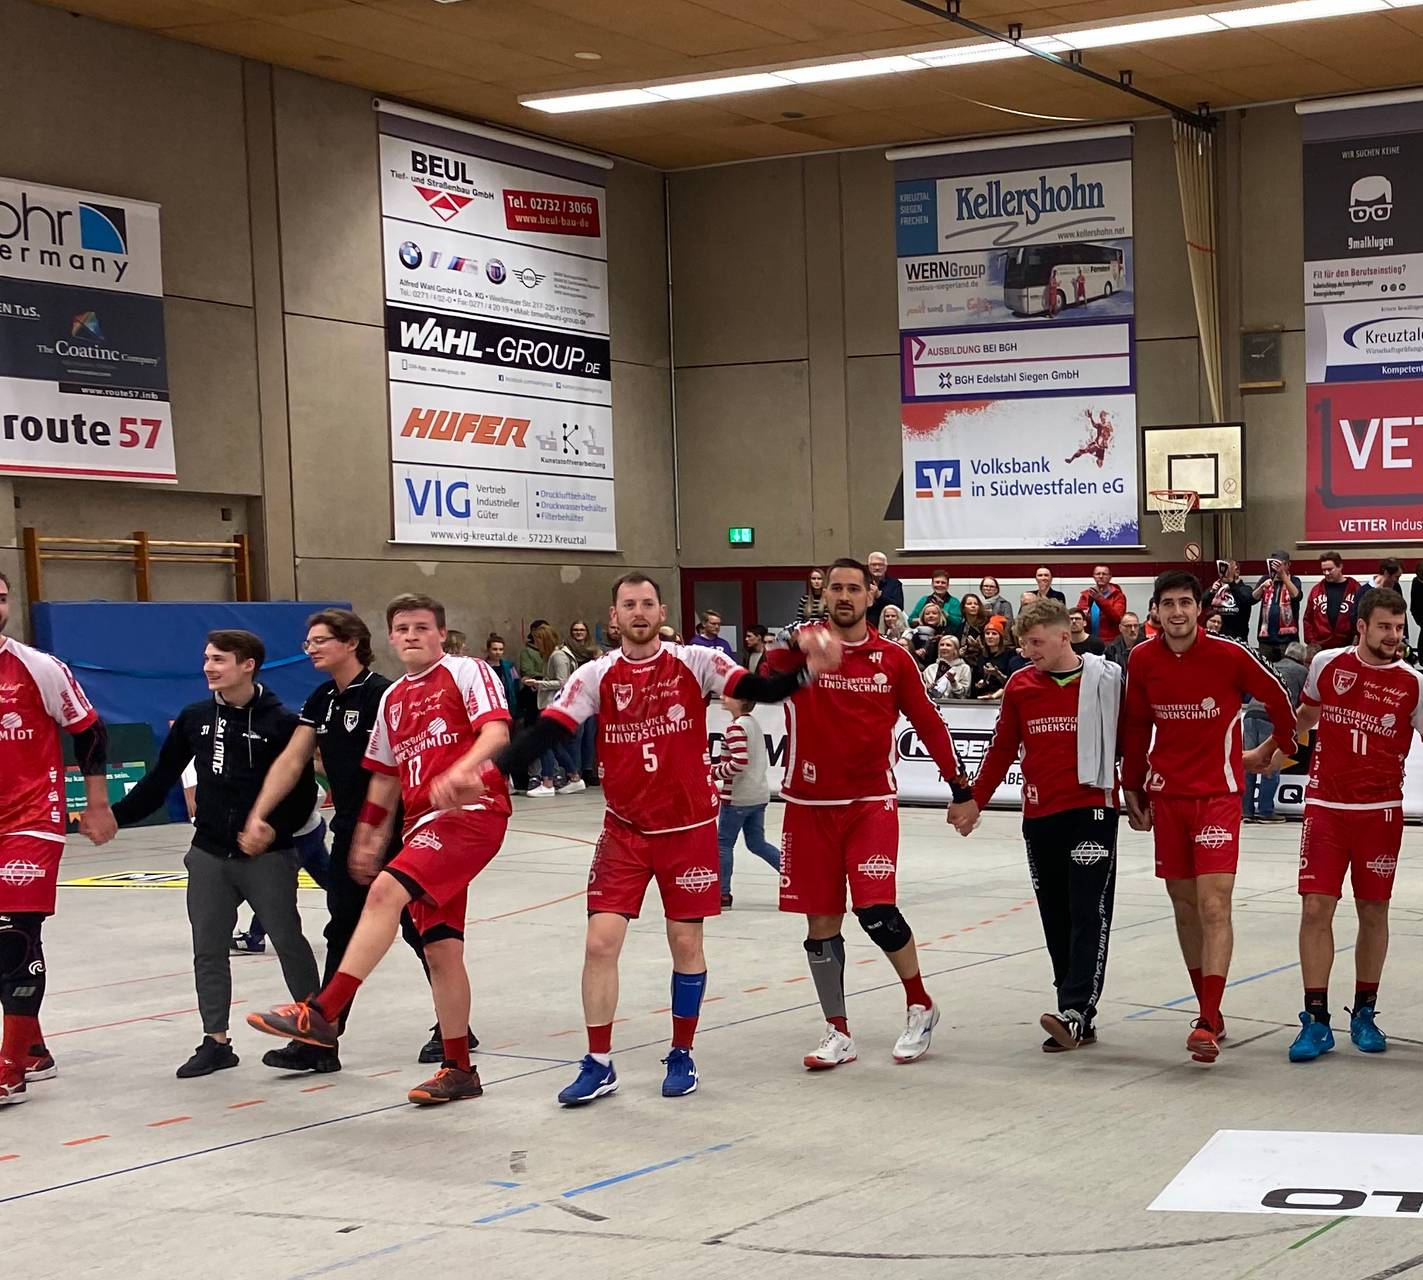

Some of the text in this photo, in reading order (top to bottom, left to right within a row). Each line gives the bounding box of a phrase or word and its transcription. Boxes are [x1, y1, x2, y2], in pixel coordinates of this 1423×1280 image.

[1342, 145, 1400, 160] WIR SUCHEN KEINE
[411, 150, 474, 185] BEUL
[411, 175, 425, 185] und
[427, 178, 470, 196] Straßenbau
[472, 188, 495, 200] GmbH
[507, 195, 593, 215] Tel. 02732 3066
[955, 172, 1105, 226] Kellershohn
[905, 260, 986, 281] WERNGroup
[17, 303, 41, 318] TuS.
[55, 340, 120, 362] Coatinc
[400, 317, 601, 374] WAHL-GROUP.DE
[927, 342, 1018, 357] AUSBILDUNG BEI BGH
[954, 369, 1080, 385] BGH Edelstahl Siegen GmbH
[80, 386, 159, 400] www.route57.info
[4, 413, 163, 449] route 57
[400, 407, 532, 448] HUFER
[970, 456, 1051, 475] Volksbank
[476, 483, 506, 495] Vertrieb
[971, 477, 1125, 498] in Südwestfalen eG
[405, 477, 472, 519] VIG
[476, 497, 521, 508] Industrieller
[476, 509, 499, 520] Güter
[1339, 519, 1387, 532] VETTER
[430, 528, 587, 545] www.vig-kreuztal.de 57223 Kreuztal
[1028, 723, 1077, 735] LINDENSCH
[1349, 729, 1368, 755] 11
[642, 743, 659, 773] 5
[1092, 808, 1105, 821] 16
[1383, 808, 1393, 822] 11
